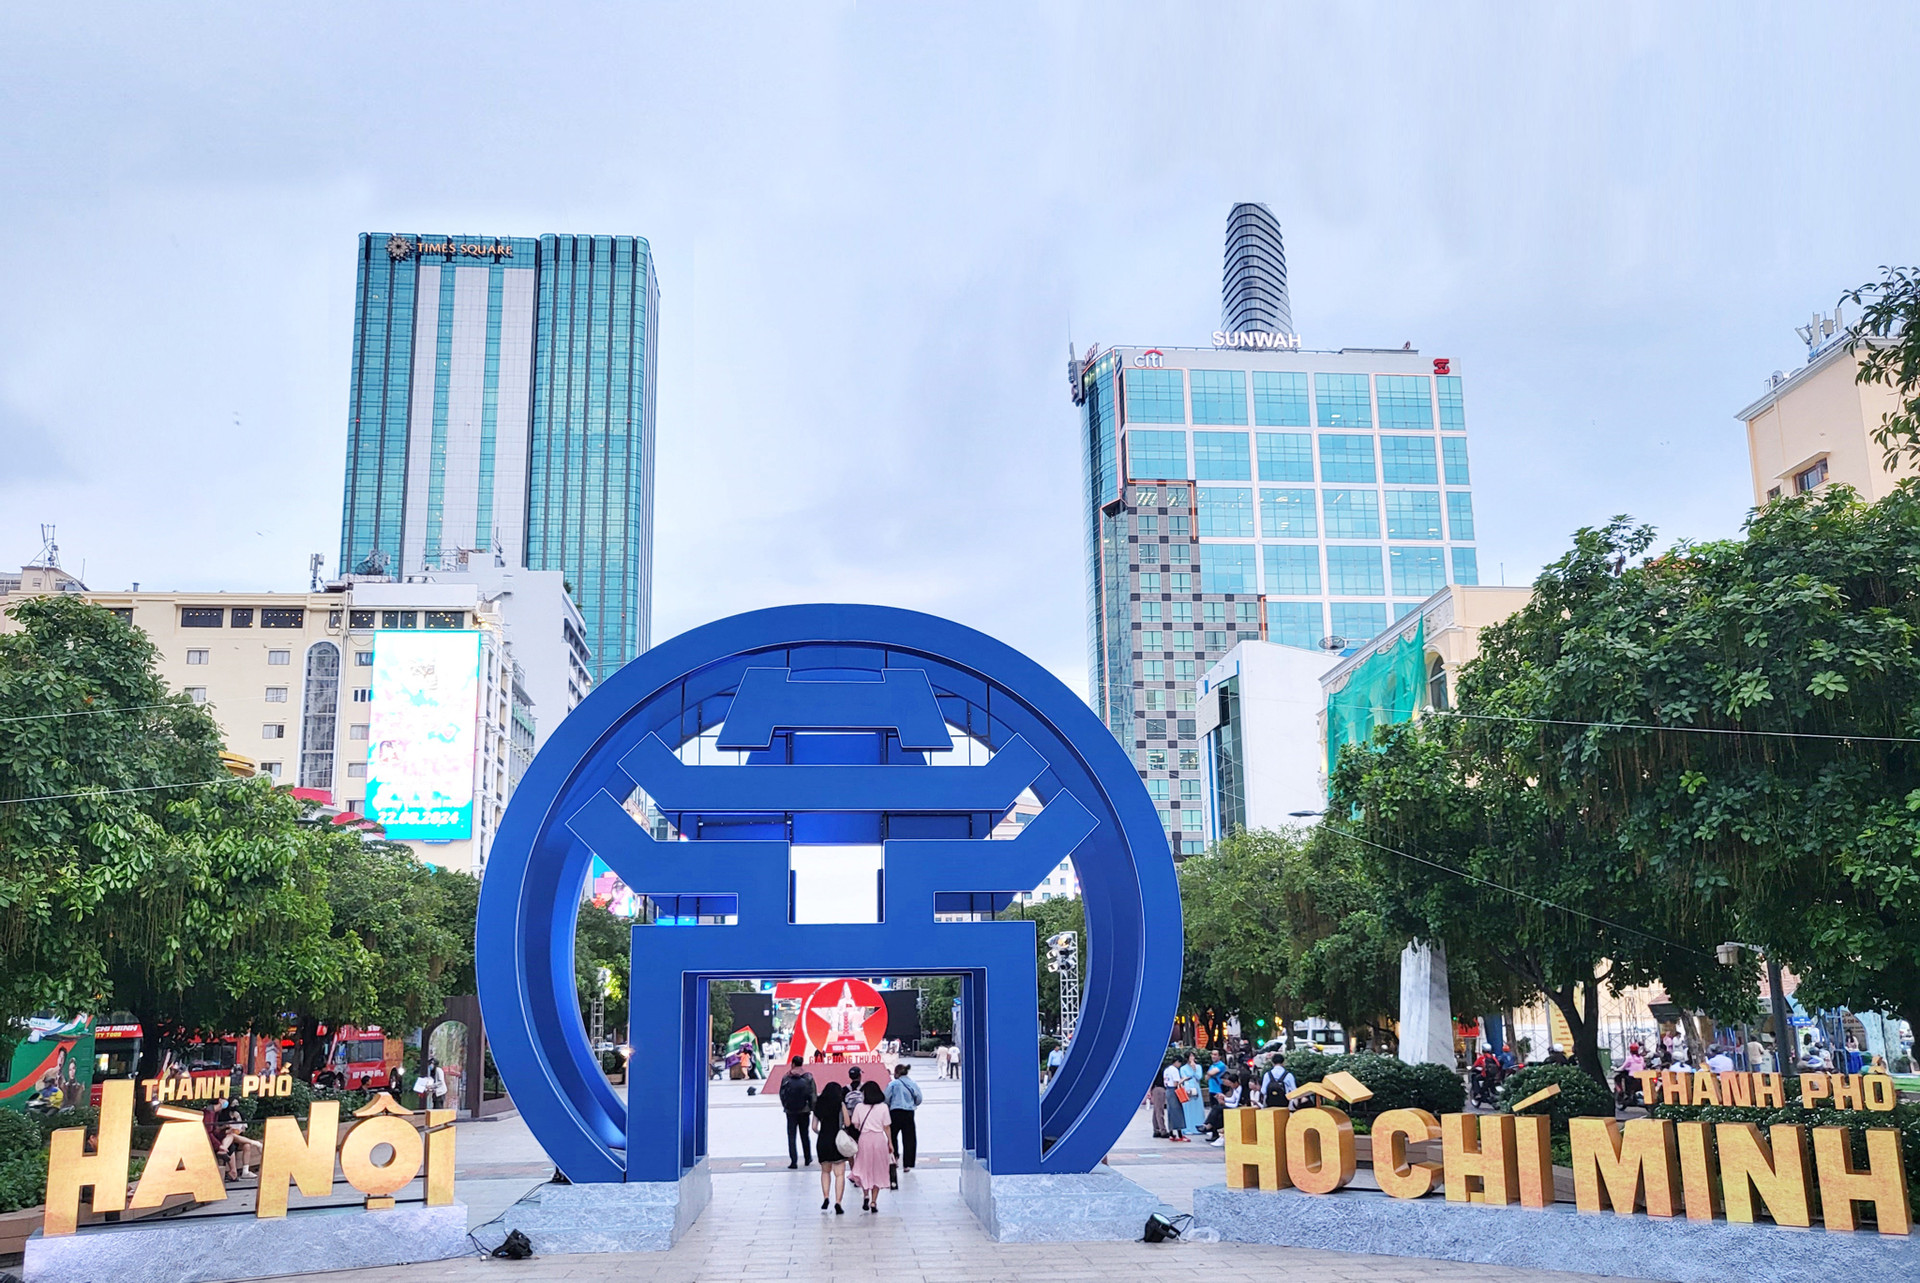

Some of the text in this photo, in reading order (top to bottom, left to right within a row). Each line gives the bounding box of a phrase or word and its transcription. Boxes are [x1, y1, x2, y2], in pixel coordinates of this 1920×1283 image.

[417, 242, 513, 256] TIMES SQUARE
[1212, 331, 1302, 348] SUNWAH
[1134, 350, 1164, 368] citi
[242, 1062, 293, 1098] PHỐ
[1634, 1055, 1897, 1112] THÀNH PHỐ
[43, 1079, 457, 1237] HÀ NỘI
[1223, 1071, 1913, 1236] HỒ CHÍ MINH
